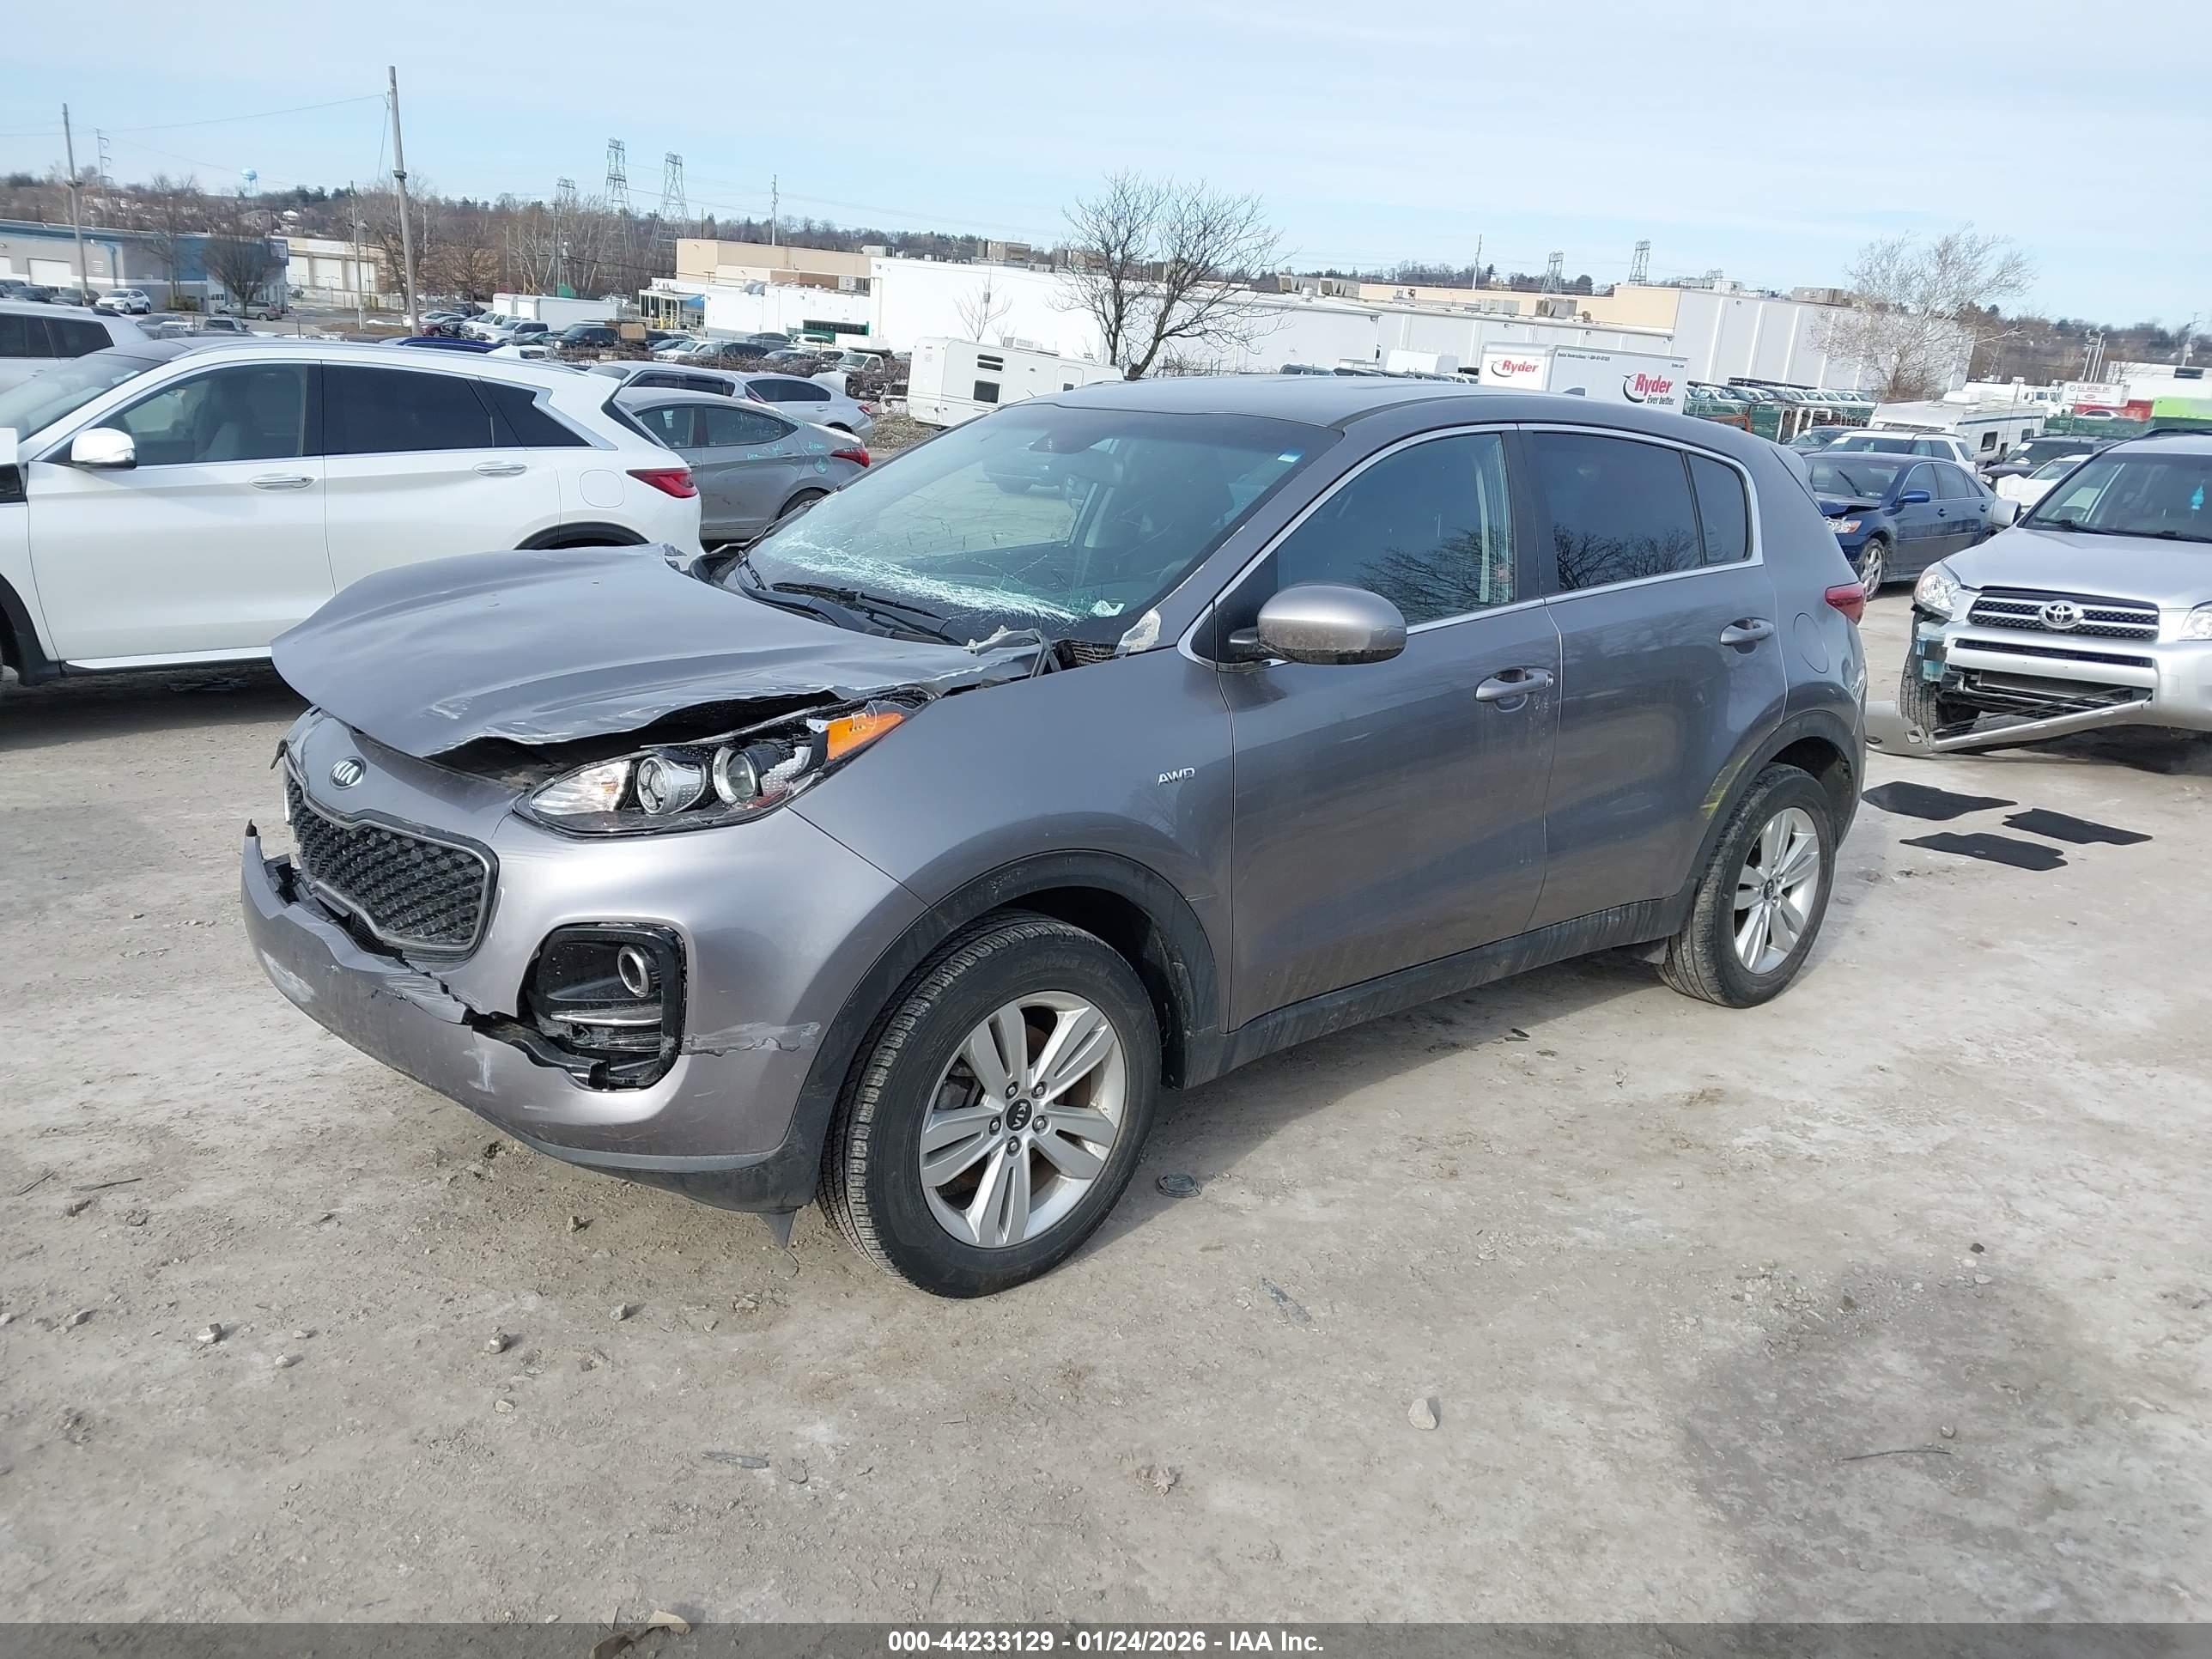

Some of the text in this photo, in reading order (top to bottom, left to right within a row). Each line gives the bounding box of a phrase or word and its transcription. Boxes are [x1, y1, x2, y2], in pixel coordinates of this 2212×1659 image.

[1502, 360, 1539, 374] Ryder
[1634, 373, 1674, 396] Ryder
[1647, 395, 1675, 405] Ever better
[332, 760, 359, 784] KIA
[1157, 767, 1195, 787] AWD
[1012, 1103, 1028, 1128] KIA
